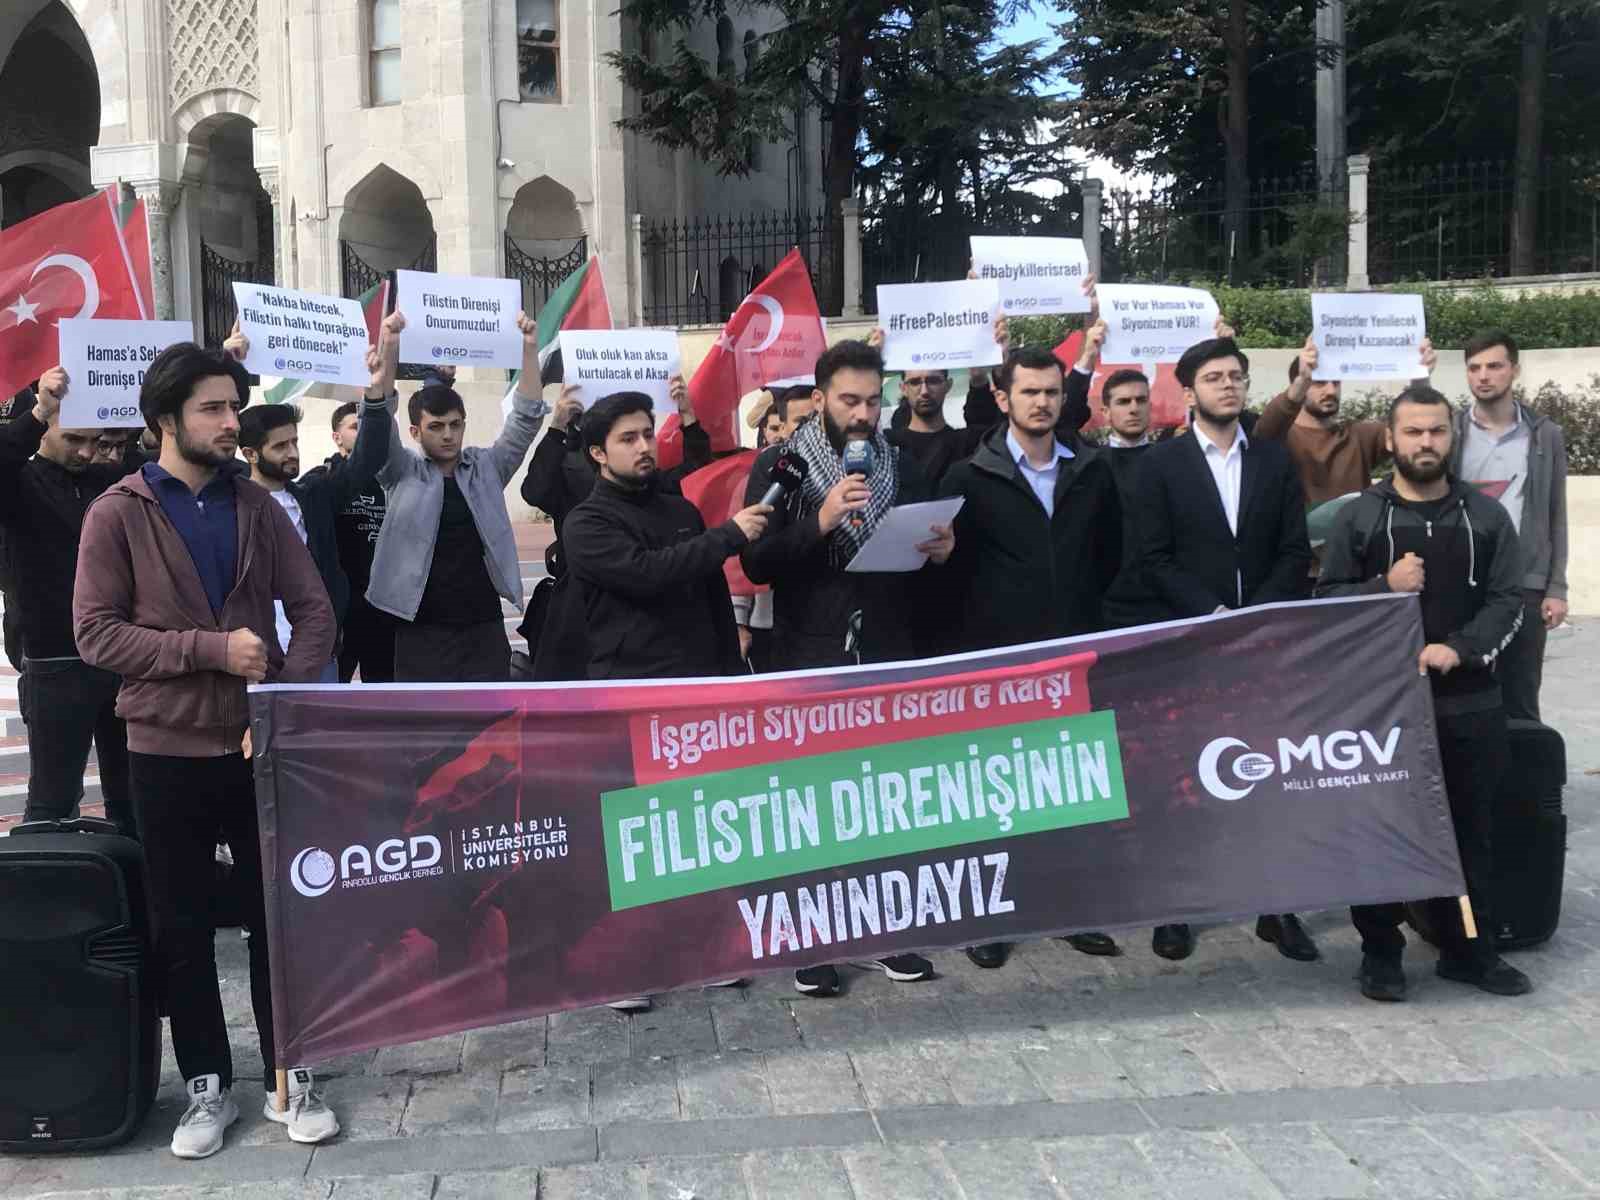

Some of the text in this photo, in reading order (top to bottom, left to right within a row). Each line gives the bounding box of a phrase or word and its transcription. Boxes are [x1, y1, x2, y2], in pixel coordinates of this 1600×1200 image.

[981, 262, 1082, 280] #babykillerisrael
[300, 298, 344, 318] bitecek,
[422, 293, 501, 316] Filistin Direnişi
[1112, 300, 1205, 311] Vur Vur Hamas Vur
[243, 308, 366, 338] Filistin halkı toprağına
[425, 315, 500, 333] Onurumuzdur!
[889, 308, 989, 331] #FreePalestine
[1121, 316, 1200, 332] Siyonizme VUR!
[267, 334, 290, 349] geri
[87, 345, 137, 361] Hamas'a
[443, 347, 468, 357] AGD
[576, 348, 668, 361] Oluk oluk kan aksa
[287, 360, 312, 370] AGD
[578, 367, 632, 380] kurtulacak
[634, 367, 643, 380] el
[88, 370, 135, 390] Direnişe
[110, 407, 137, 416] AGD
[650, 709, 756, 769] İşgalci
[763, 697, 885, 746] Siyonist
[1277, 726, 1402, 774] MGV
[1317, 773, 1371, 789] GENÇLİK
[1374, 769, 1410, 784] VAKFI
[618, 729, 1112, 883] FİLİSTİN DİRENİŞİNİN
[462, 816, 567, 841] İSTANBUL
[462, 830, 567, 856] ÜNİVERSİTELER
[340, 834, 442, 880] AGD
[464, 844, 568, 871] KOMİSYONU
[737, 851, 1016, 960] YANINDAYIZ
